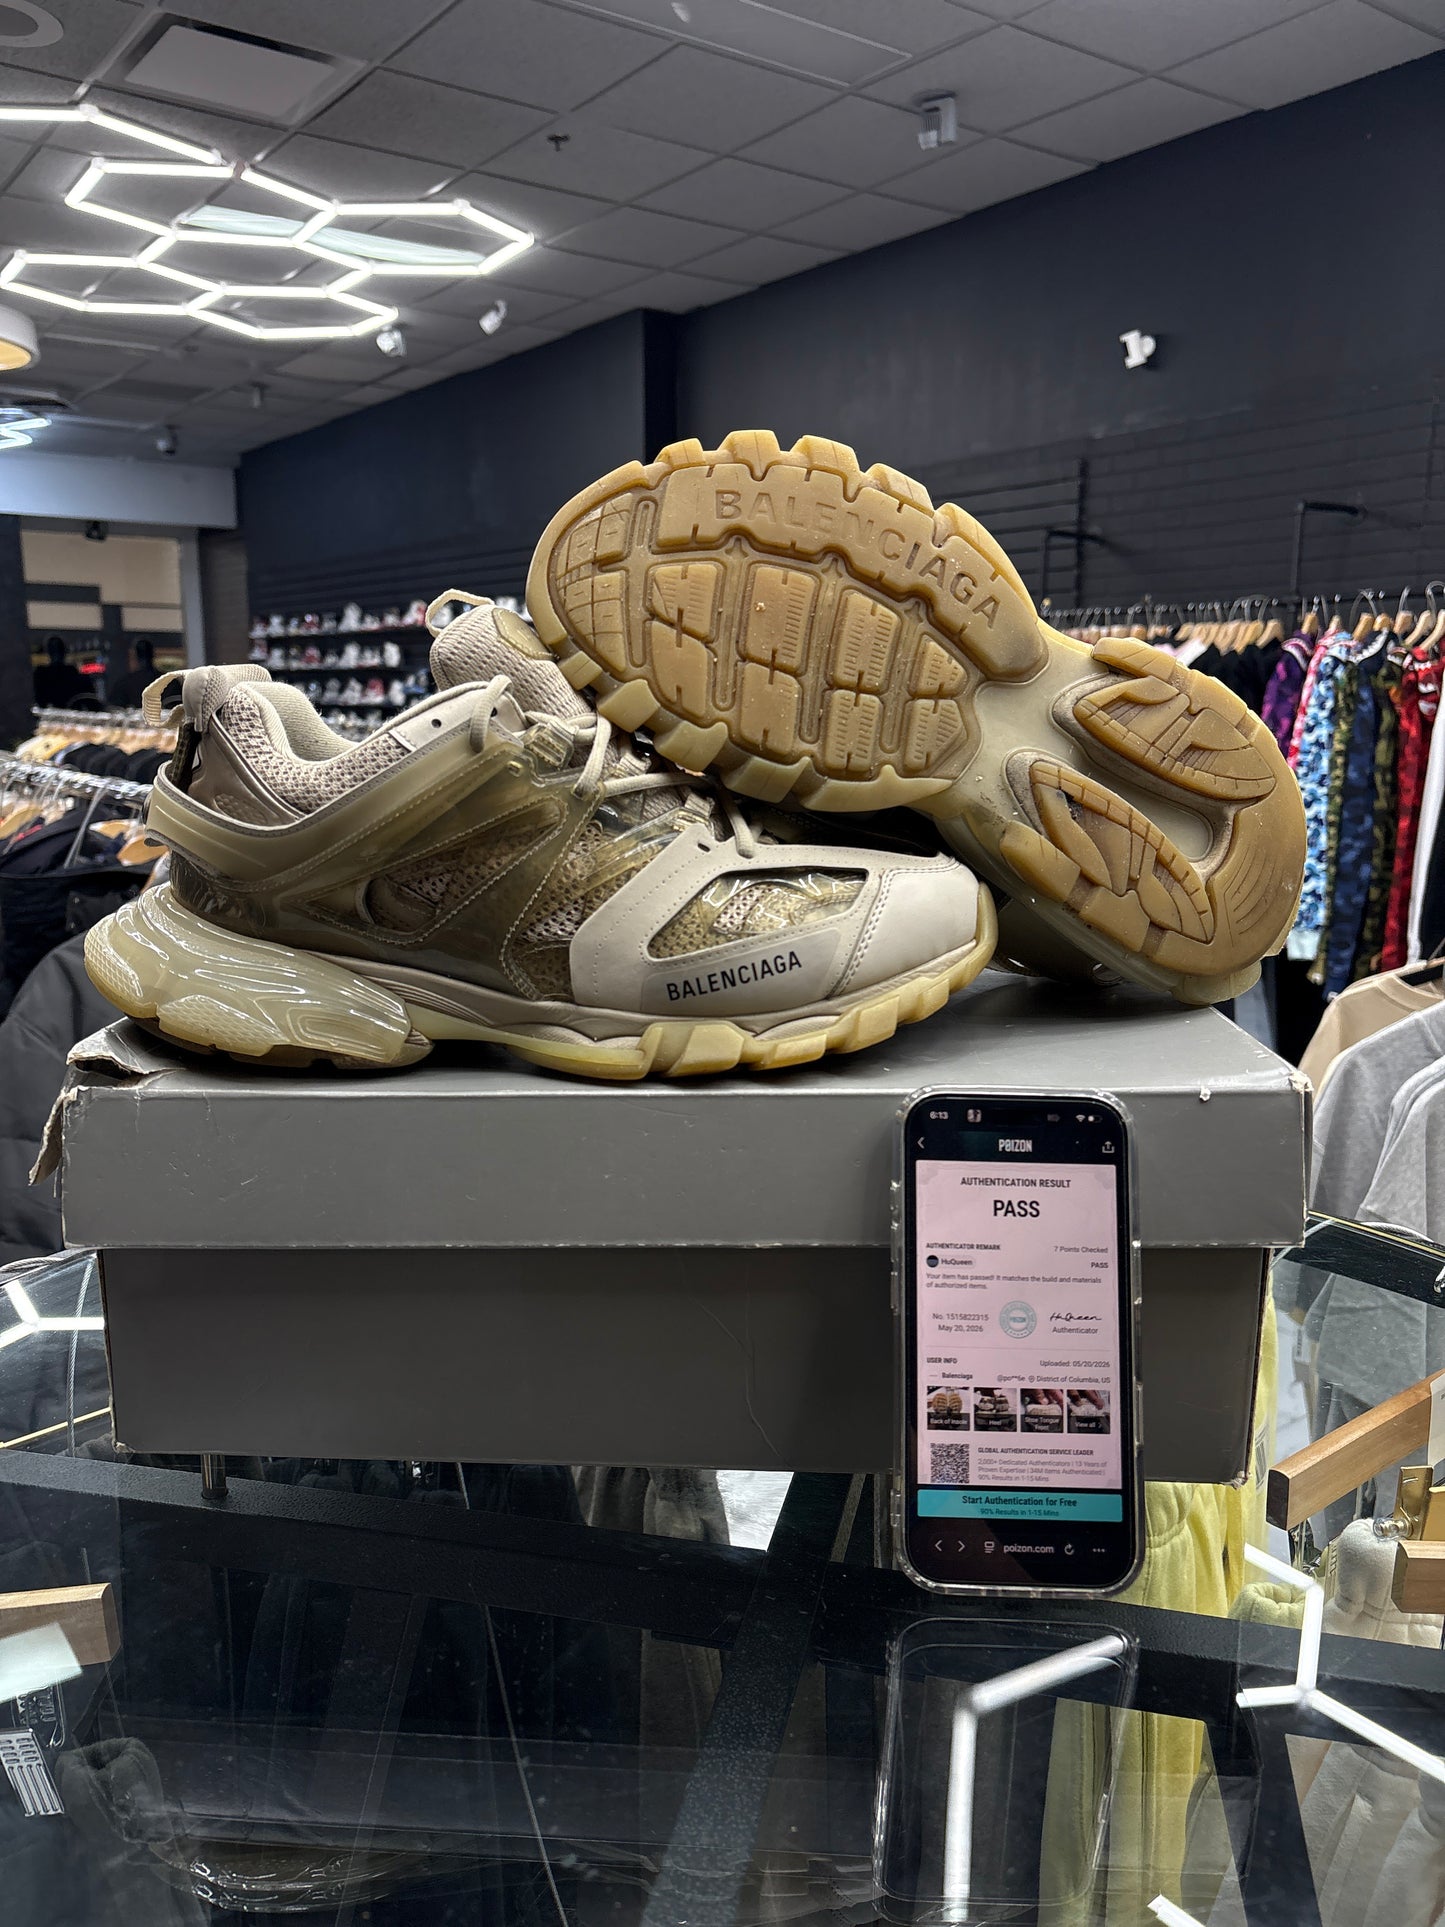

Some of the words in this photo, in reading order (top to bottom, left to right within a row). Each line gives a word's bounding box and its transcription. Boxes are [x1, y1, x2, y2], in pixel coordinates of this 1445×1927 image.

[715, 489, 1003, 630] BALENCIAGA
[666, 951, 802, 1001] BALENCIAGA
[929, 1111, 949, 1120] 6:13
[998, 1139, 1033, 1152] POIZON
[960, 1177, 1037, 1187] AUTHENTICATION
[1039, 1179, 1071, 1188] RESULT
[993, 1200, 1040, 1218] PASS
[926, 1242, 974, 1250] AUTHENTICATOR
[941, 1258, 973, 1266] HuQueen
[938, 1324, 953, 1333] May
[954, 1325, 965, 1333] 20,
[1052, 1326, 1098, 1334] Authenticator
[942, 1372, 973, 1380] Balenciaga
[1068, 1376, 1100, 1384] Columbia,
[962, 1495, 982, 1504] Start
[984, 1496, 1043, 1506] Authentication
[1045, 1497, 1058, 1506] for
[1059, 1498, 1078, 1507] Free
[1043, 1509, 1060, 1517] Mins
[1003, 1543, 1055, 1555] poizon.com
